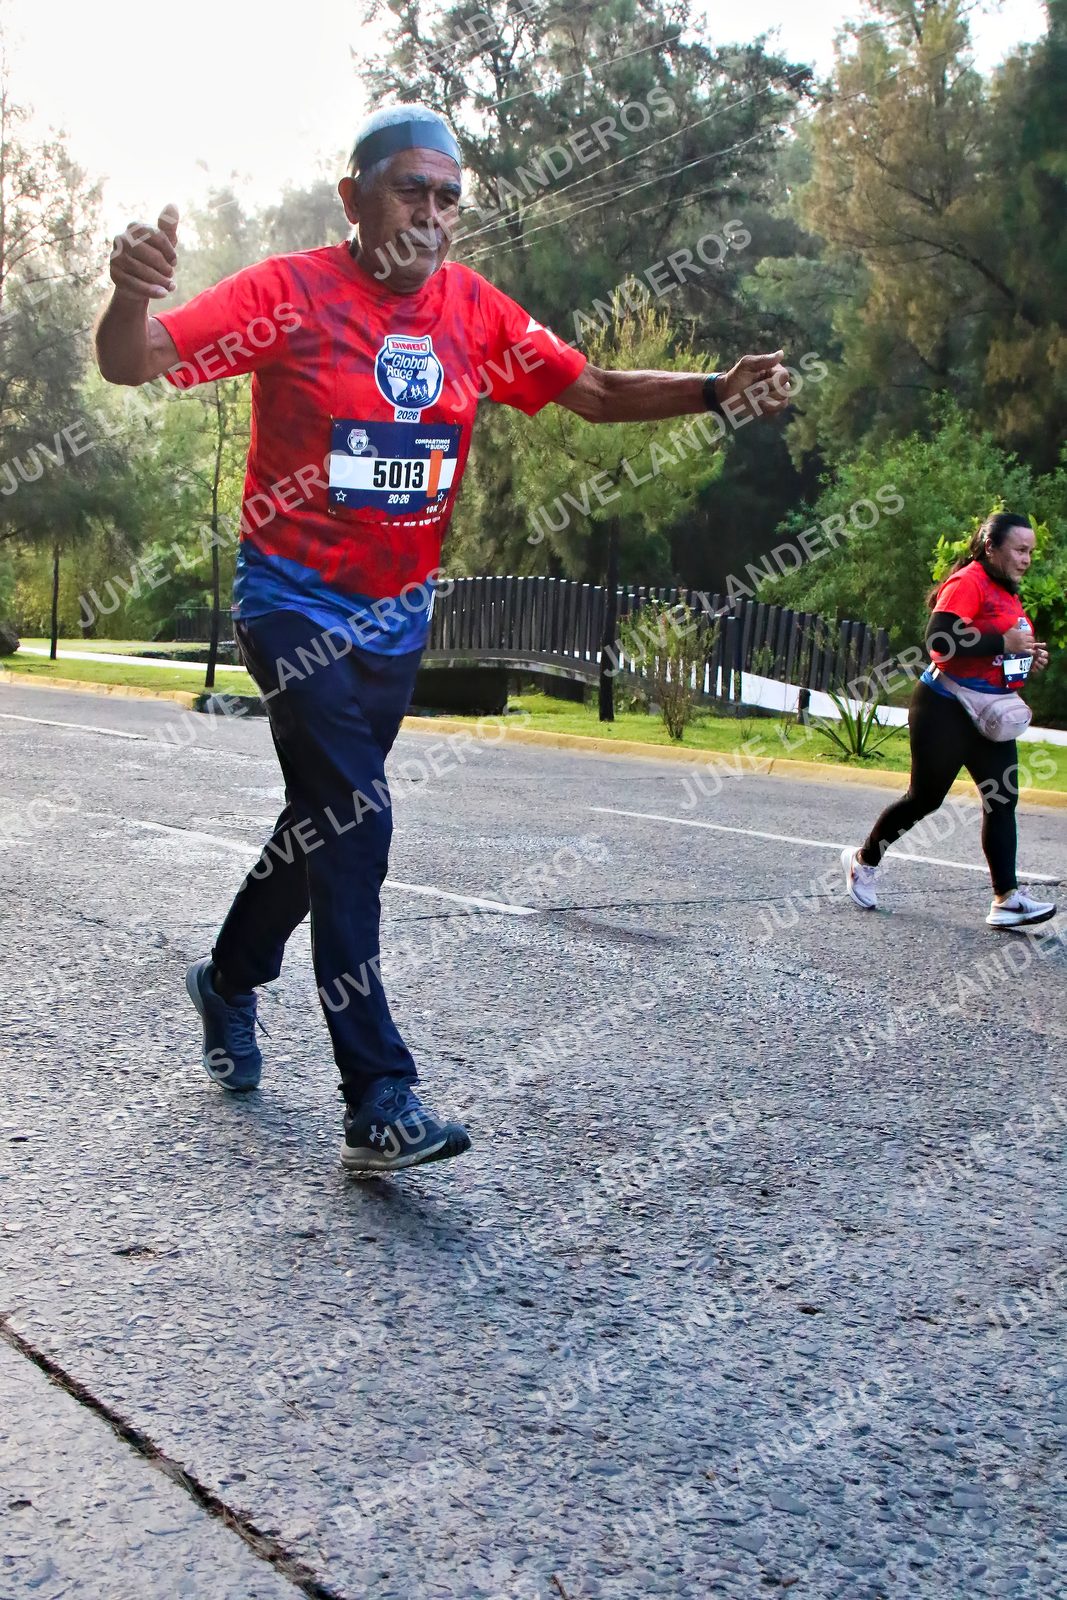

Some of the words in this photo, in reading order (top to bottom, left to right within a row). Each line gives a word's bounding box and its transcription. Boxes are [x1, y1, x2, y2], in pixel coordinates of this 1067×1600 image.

[391, 341, 428, 351] BIMBO
[392, 354, 428, 370] Global
[386, 365, 413, 380] Race
[396, 410, 418, 420] 2026
[373, 460, 424, 489] 5013
